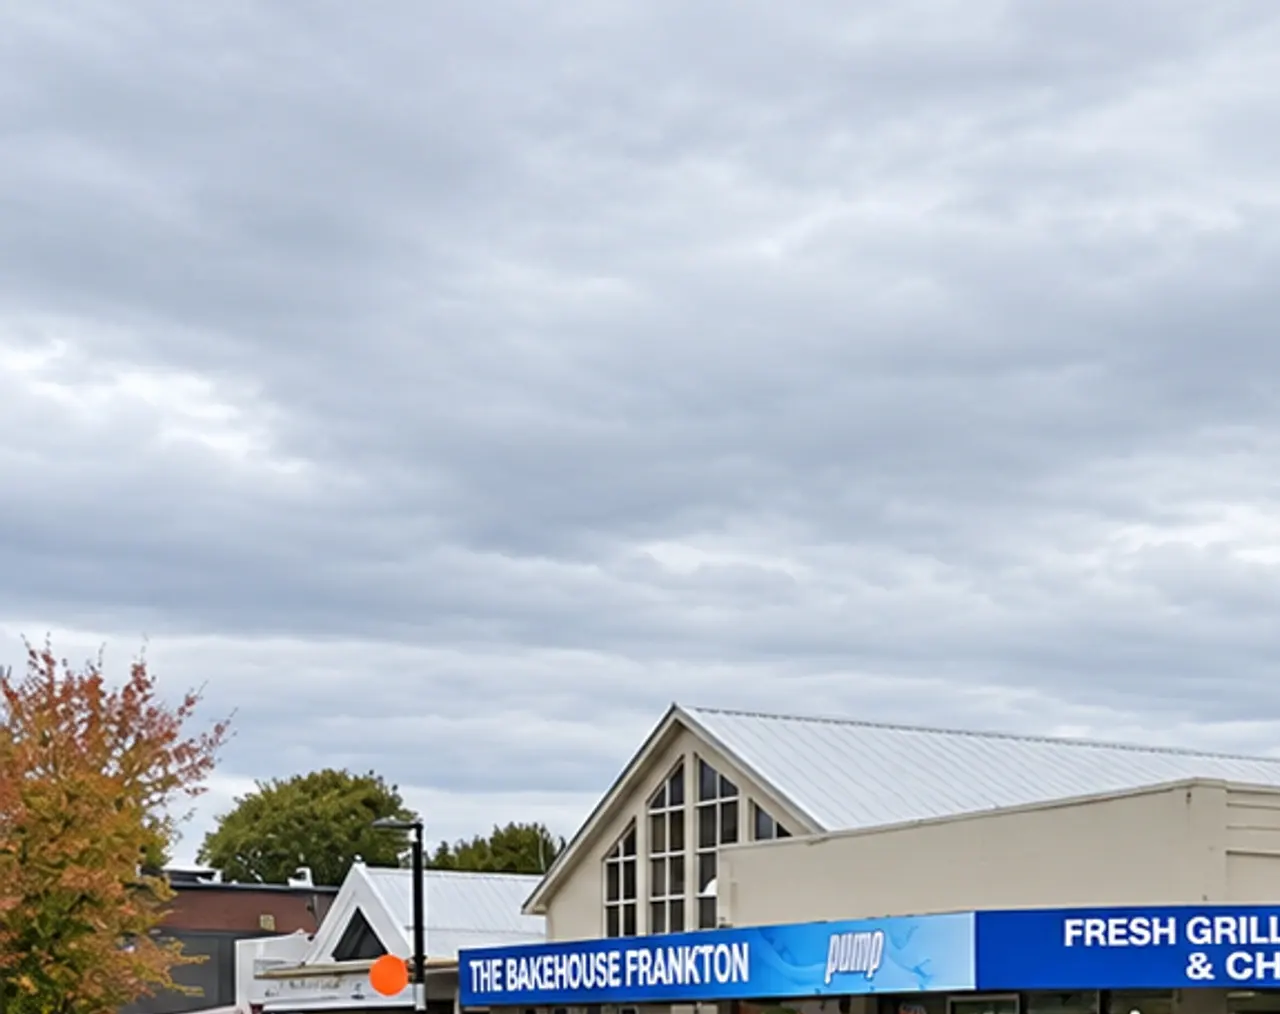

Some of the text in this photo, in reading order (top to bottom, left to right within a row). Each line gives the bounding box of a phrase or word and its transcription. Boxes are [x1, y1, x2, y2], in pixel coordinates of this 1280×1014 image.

[1064, 917, 1176, 946] FRESH
[469, 942, 749, 993] THE BAKEHOUSE FRANKTON
[824, 930, 884, 985] pump
[1186, 952, 1215, 980] &
